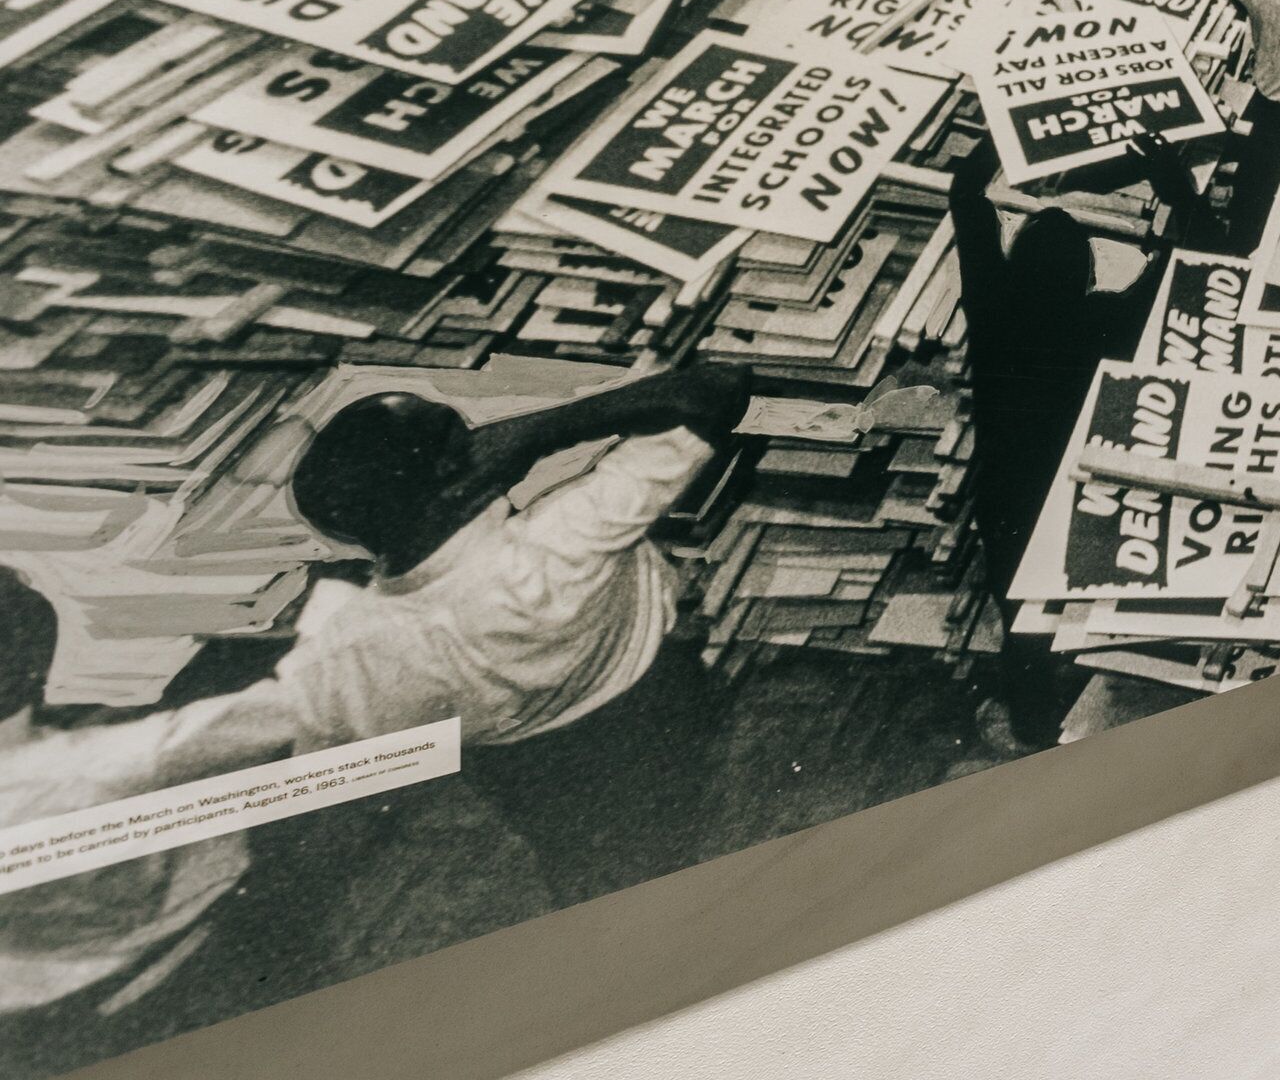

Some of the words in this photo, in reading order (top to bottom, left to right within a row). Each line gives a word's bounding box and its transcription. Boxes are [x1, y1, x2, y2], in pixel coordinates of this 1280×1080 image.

[995, 17, 1137, 54] NOW!
[1055, 44, 1147, 66] DECENT
[1150, 40, 1166, 51] A
[993, 56, 1046, 76] PAY
[1057, 68, 1109, 86] FOR
[1115, 58, 1174, 76] JOBS
[998, 76, 1047, 97] ALL
[1070, 87, 1131, 107] FOR
[629, 60, 767, 181] MARCH
[633, 87, 698, 129] WE
[701, 99, 756, 145] FOR
[1027, 90, 1181, 140] MARCH
[692, 67, 833, 203] INTEGRATED
[741, 75, 872, 210] SCHOOLS
[800, 88, 906, 211] NOW!
[1088, 119, 1147, 145] WE
[10, 842, 46, 857] days
[49, 828, 97, 847] before
[101, 819, 123, 832] the
[127, 807, 173, 826] March
[177, 804, 194, 814] on
[198, 782, 281, 809] Washington,
[285, 767, 334, 786] workers
[338, 759, 371, 772] stack
[374, 741, 435, 763] thousands
[38, 855, 52, 863] to
[57, 849, 75, 859] be
[79, 834, 129, 853] carried
[133, 826, 151, 841] by
[243, 792, 288, 811] August
